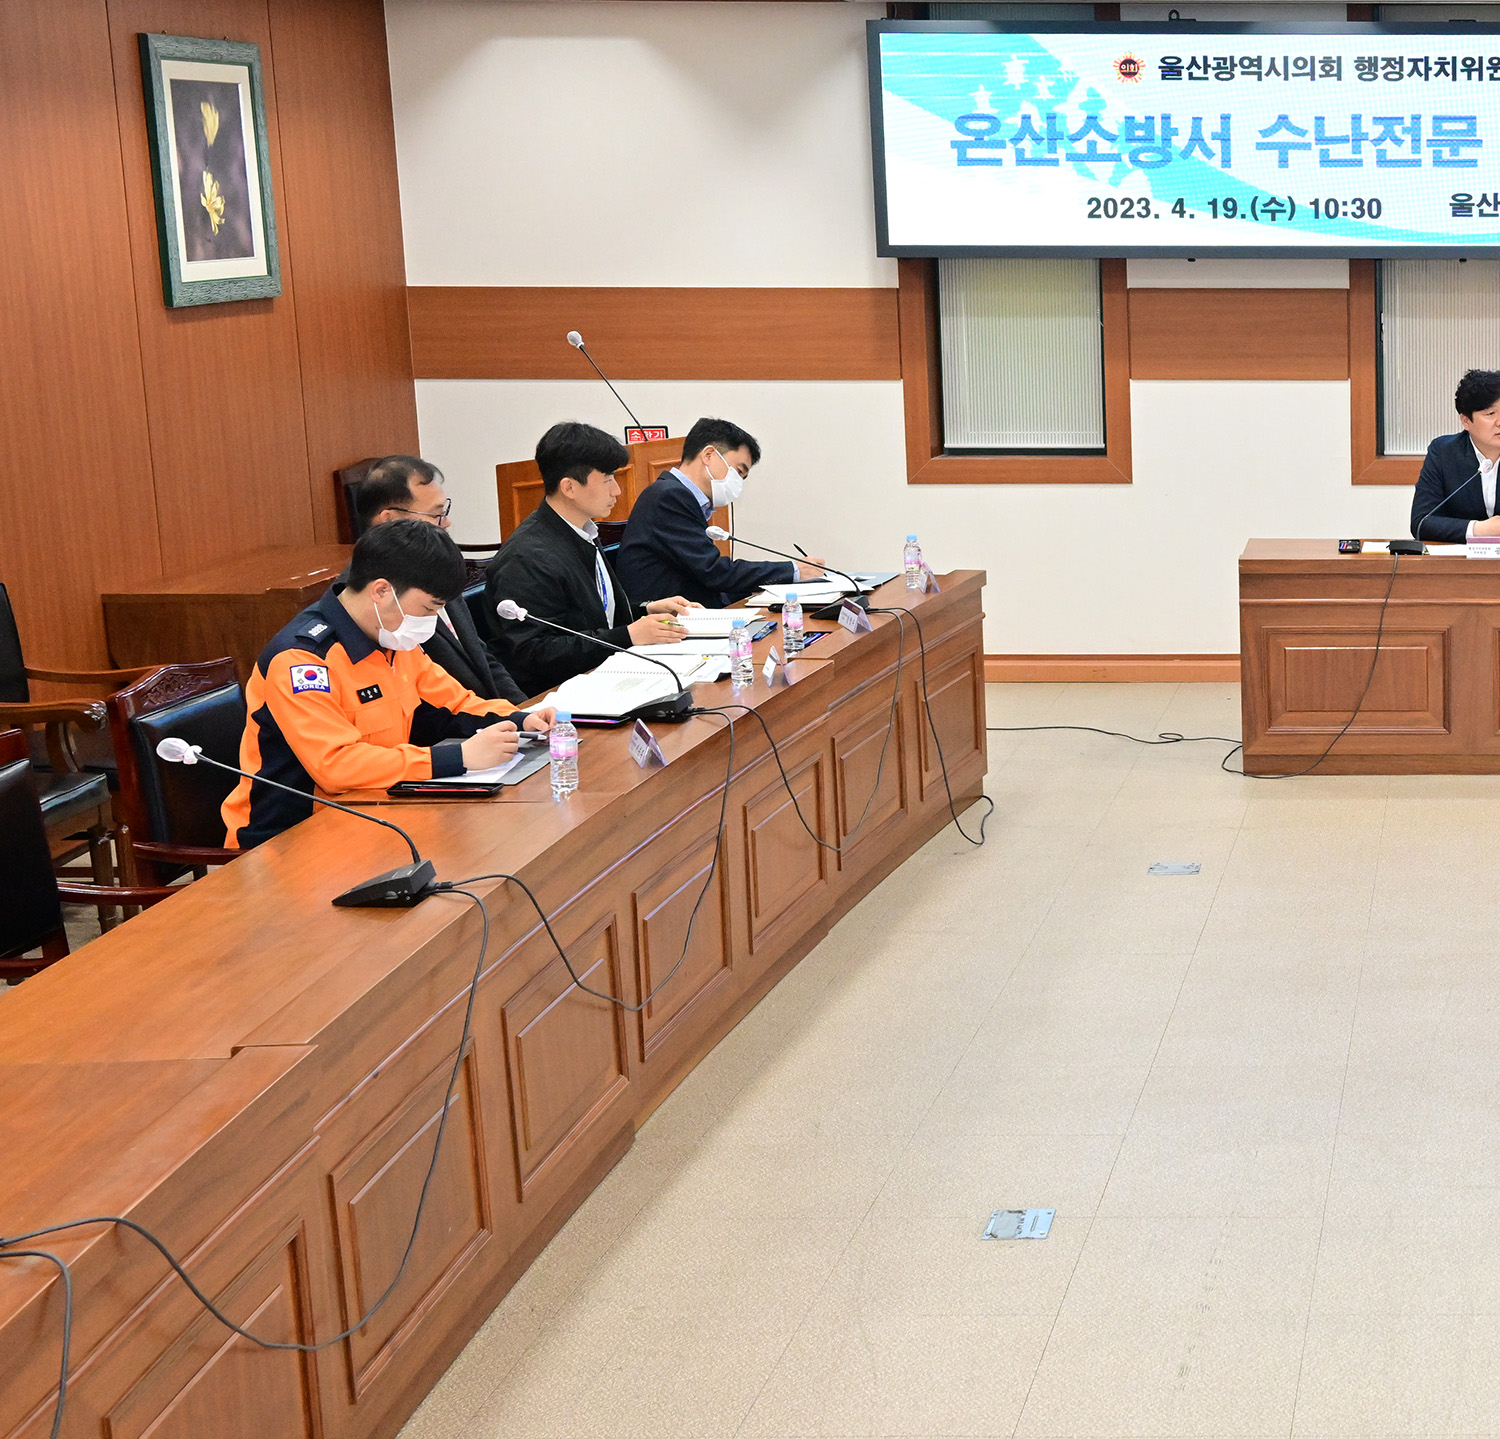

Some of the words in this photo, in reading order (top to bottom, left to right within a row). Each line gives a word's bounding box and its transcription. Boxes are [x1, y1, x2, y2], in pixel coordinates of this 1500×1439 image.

[1158, 56, 1342, 82] 울산광역시의회
[950, 113, 1232, 169] 온산소방서
[1255, 114, 1483, 168] 수난전문
[1087, 197, 1160, 219] 2023.
[1171, 197, 1195, 219] 4.
[1207, 196, 1296, 222] 19.(수)
[1309, 197, 1382, 219] 10:30
